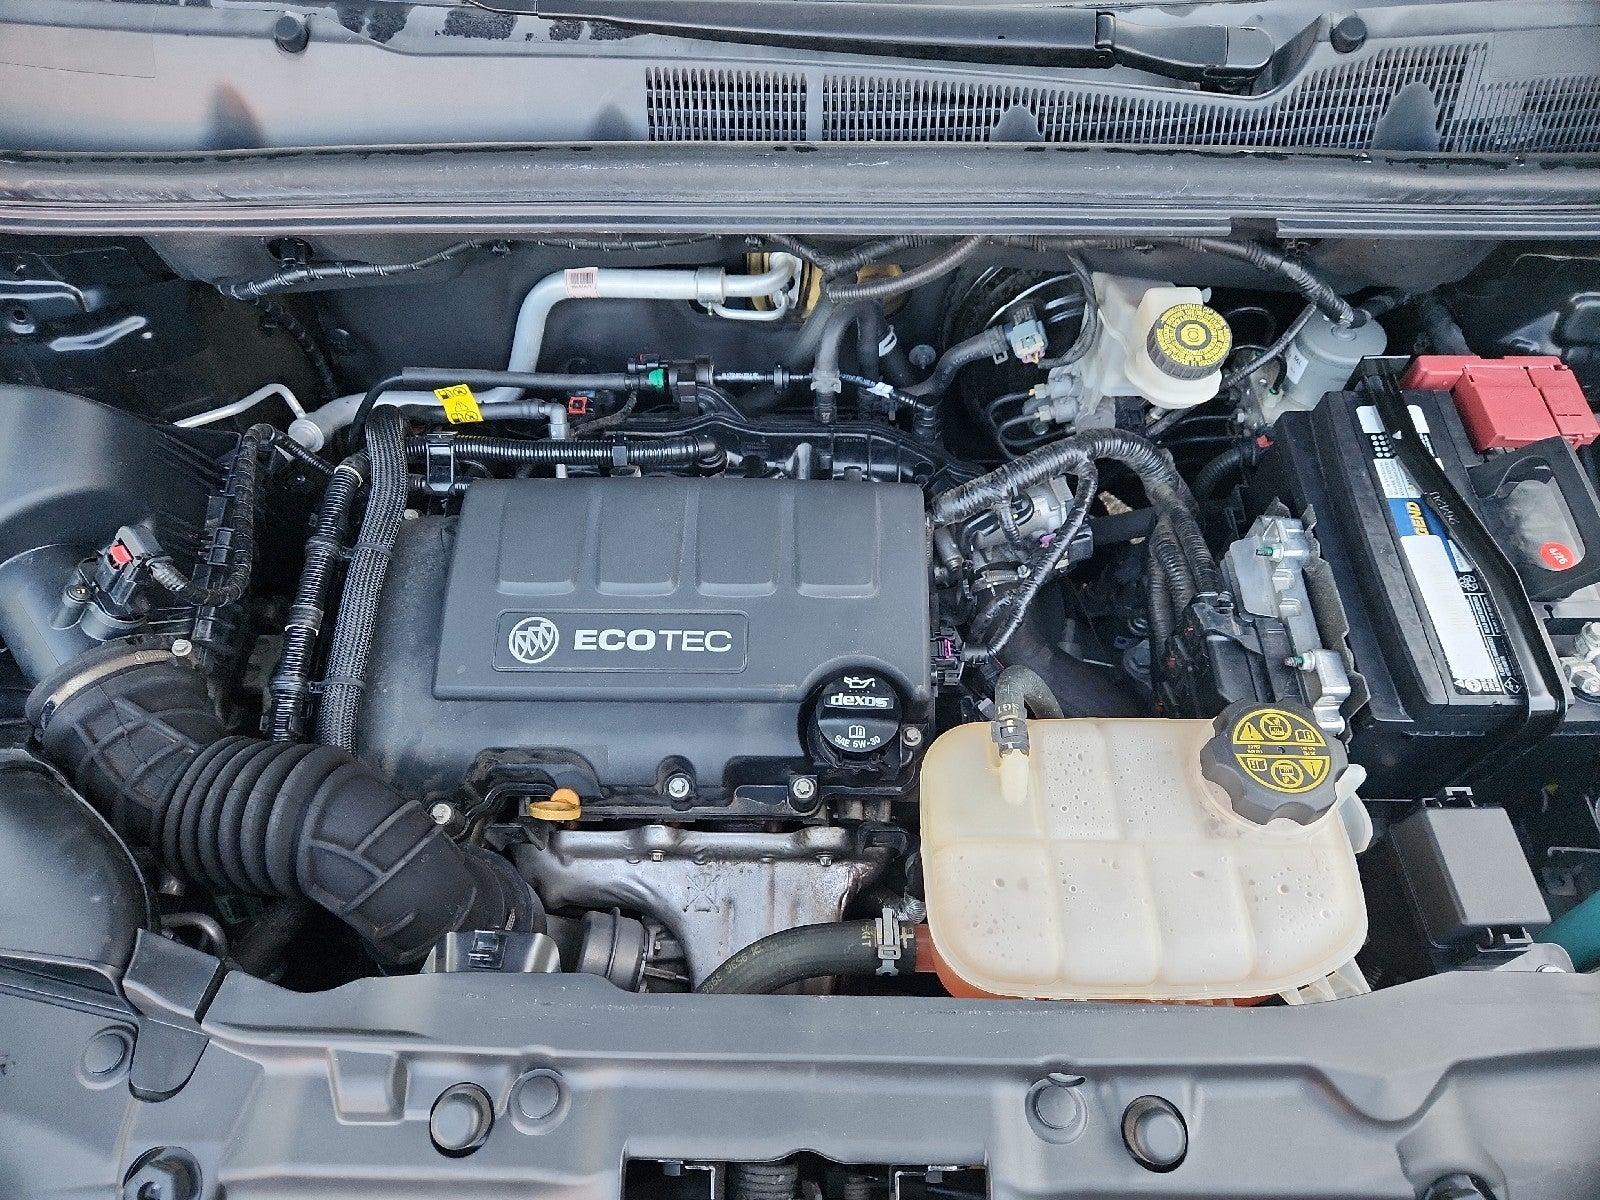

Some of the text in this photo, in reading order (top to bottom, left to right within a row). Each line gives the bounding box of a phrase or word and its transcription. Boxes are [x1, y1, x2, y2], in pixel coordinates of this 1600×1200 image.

[573, 629, 733, 652] ECOTEC
[830, 692, 890, 708] dexos
[834, 735, 881, 748] SAE 5W-30
[725, 953, 748, 973] 9536
